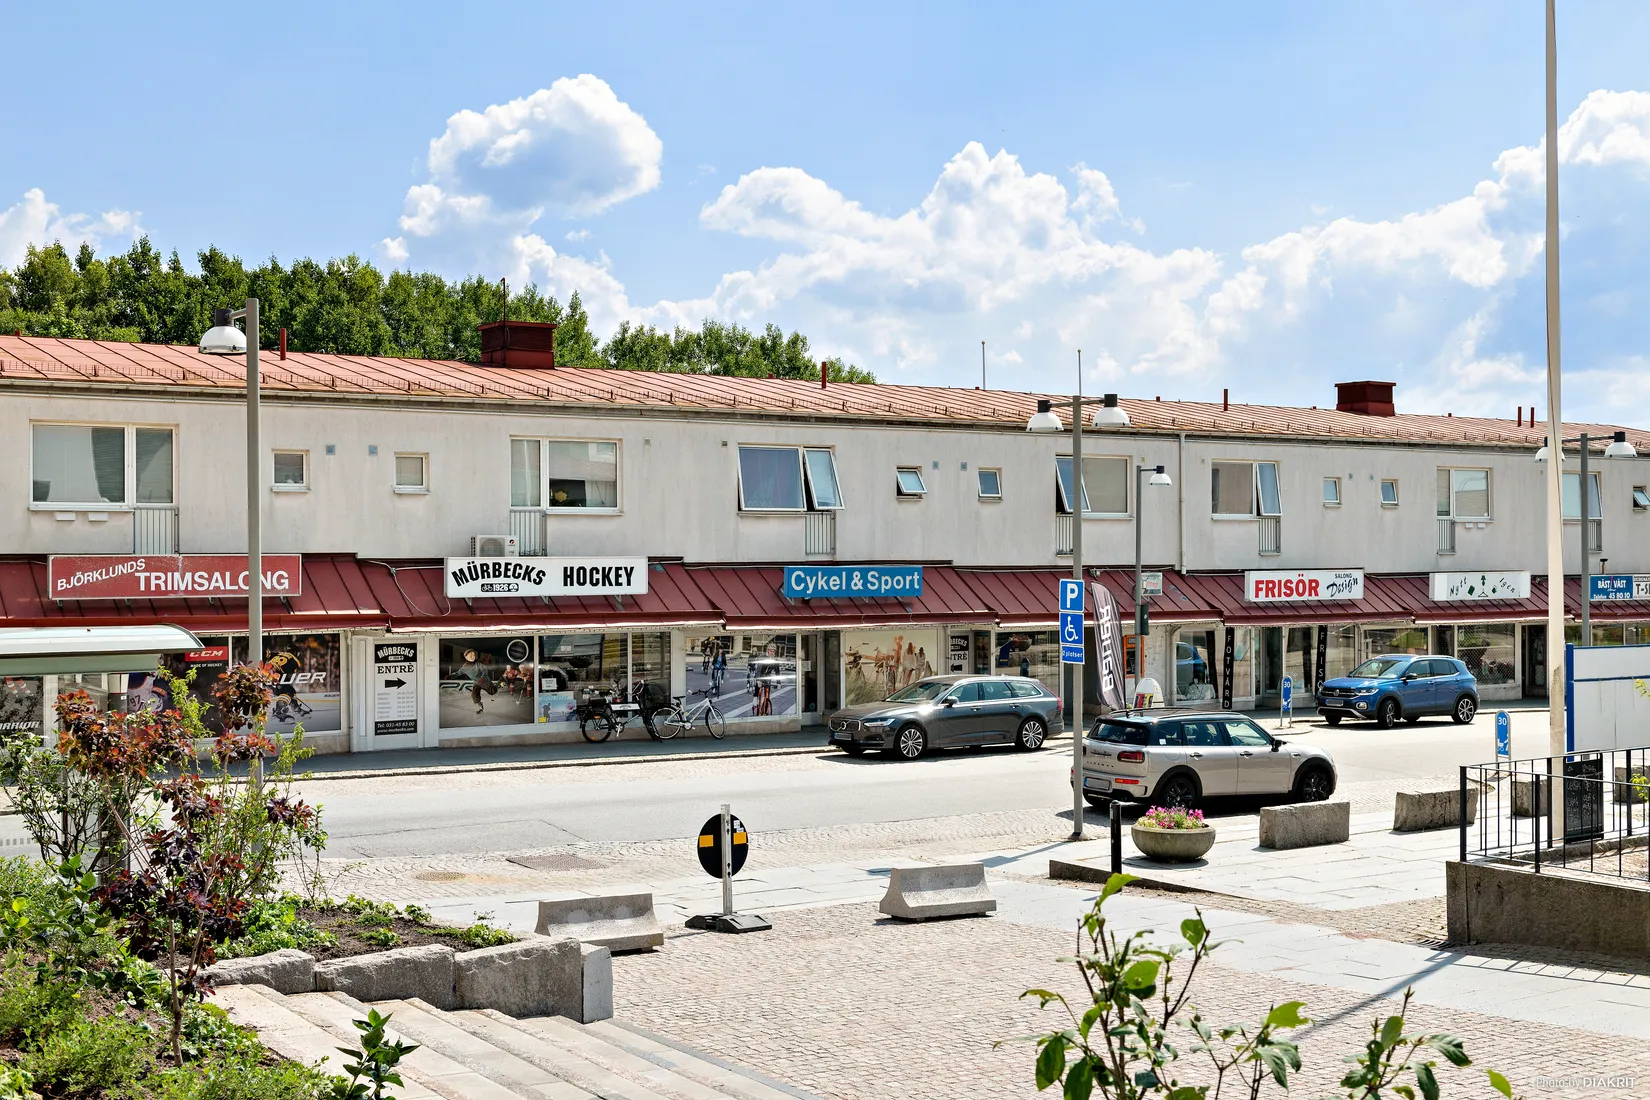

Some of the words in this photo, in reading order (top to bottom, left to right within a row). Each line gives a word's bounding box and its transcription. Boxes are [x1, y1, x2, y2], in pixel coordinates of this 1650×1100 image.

[57, 558, 146, 591] BJÖRKLUNDS
[451, 561, 546, 587] MÜRBECKS
[563, 566, 635, 587] HOCKEY
[791, 571, 846, 594] Cykel
[851, 571, 864, 590] &
[867, 571, 920, 593] Sport
[1597, 578, 1611, 588] BÄST
[1613, 578, 1627, 588] VÄST
[1066, 584, 1079, 608] P
[1254, 574, 1320, 598] FRISÖR
[1326, 577, 1358, 597] Design
[1635, 583, 1650, 595] T-S
[377, 646, 415, 659] MÜRBECKS
[1317, 632, 1325, 689] FRISÖ
[1223, 635, 1232, 708] FOTVÅRD
[1498, 717, 1508, 726] 30
